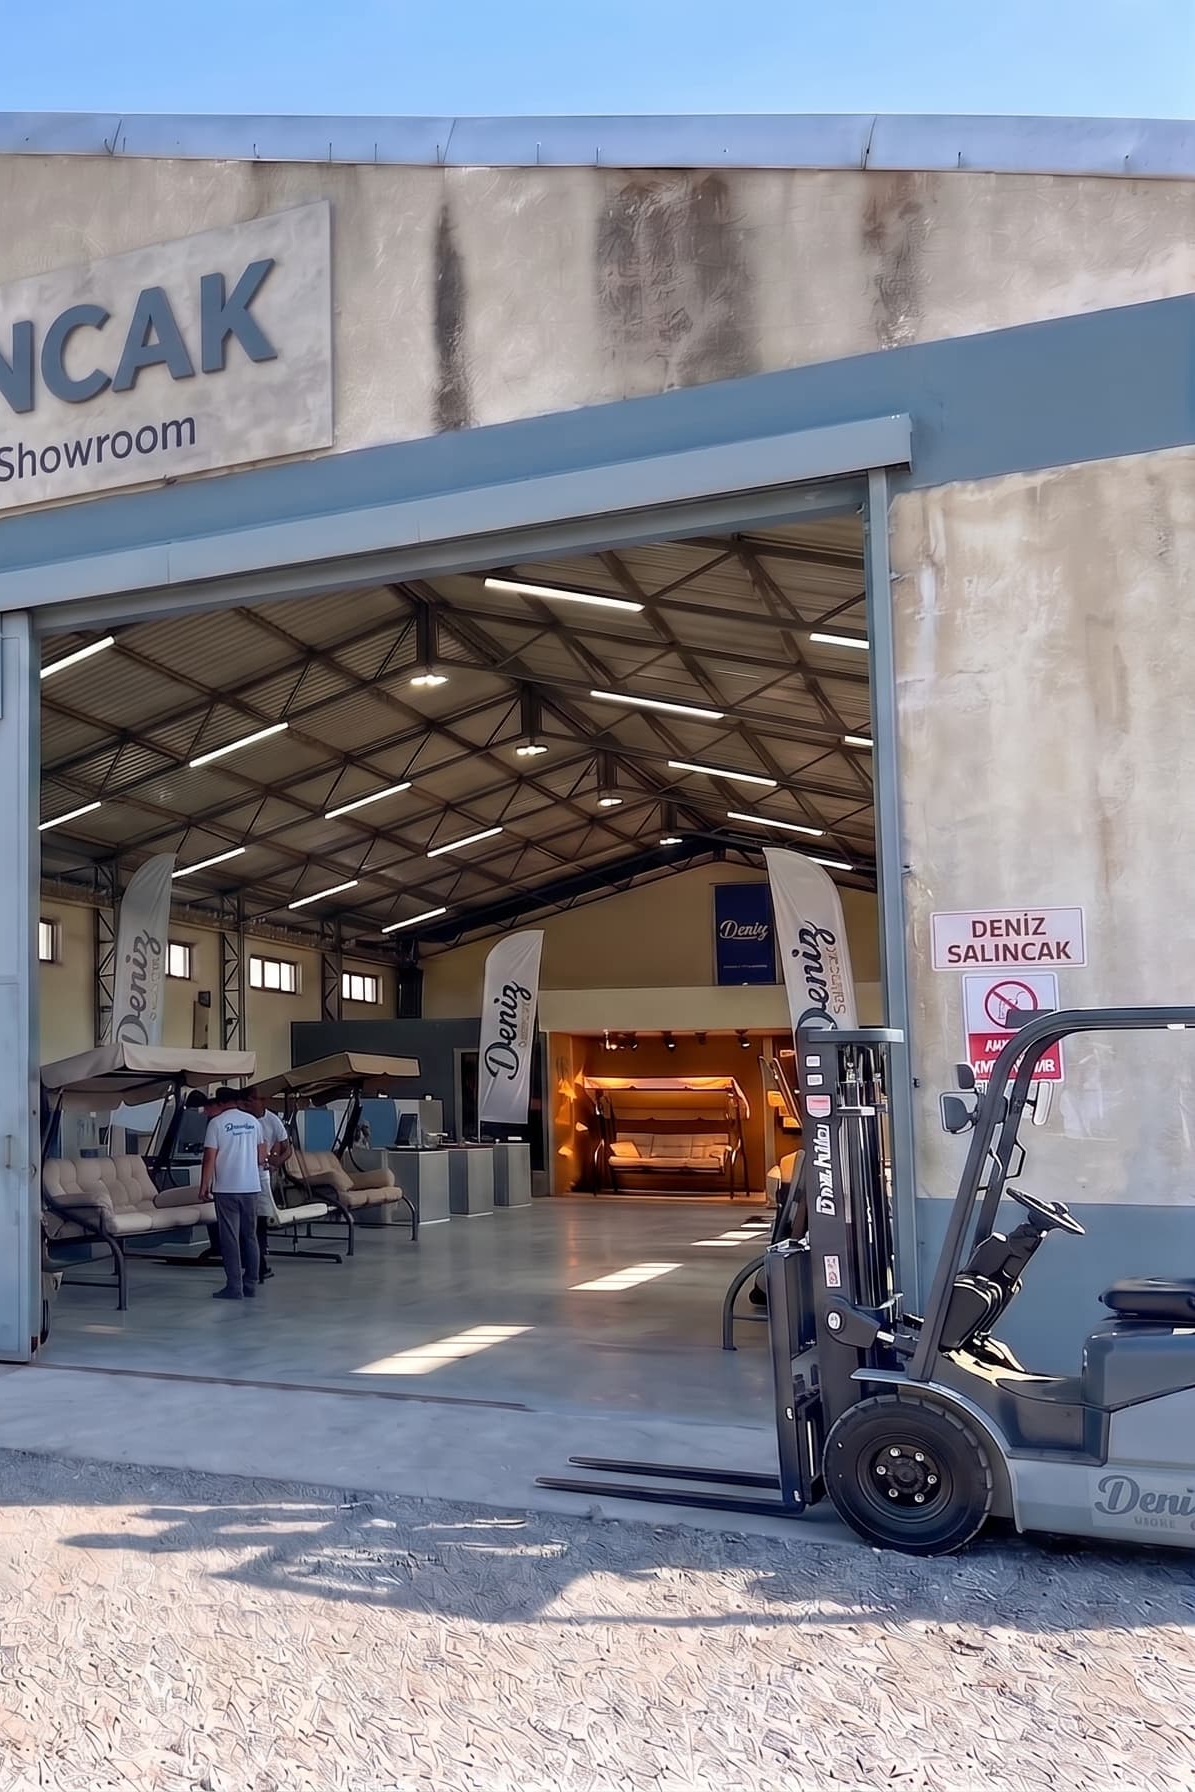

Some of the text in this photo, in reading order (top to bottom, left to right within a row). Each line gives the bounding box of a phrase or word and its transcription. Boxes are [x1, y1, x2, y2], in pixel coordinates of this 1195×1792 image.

[971, 912, 1047, 938] DENİZ
[947, 940, 1072, 964] SALINCAK
[484, 980, 532, 1080] Deniz
